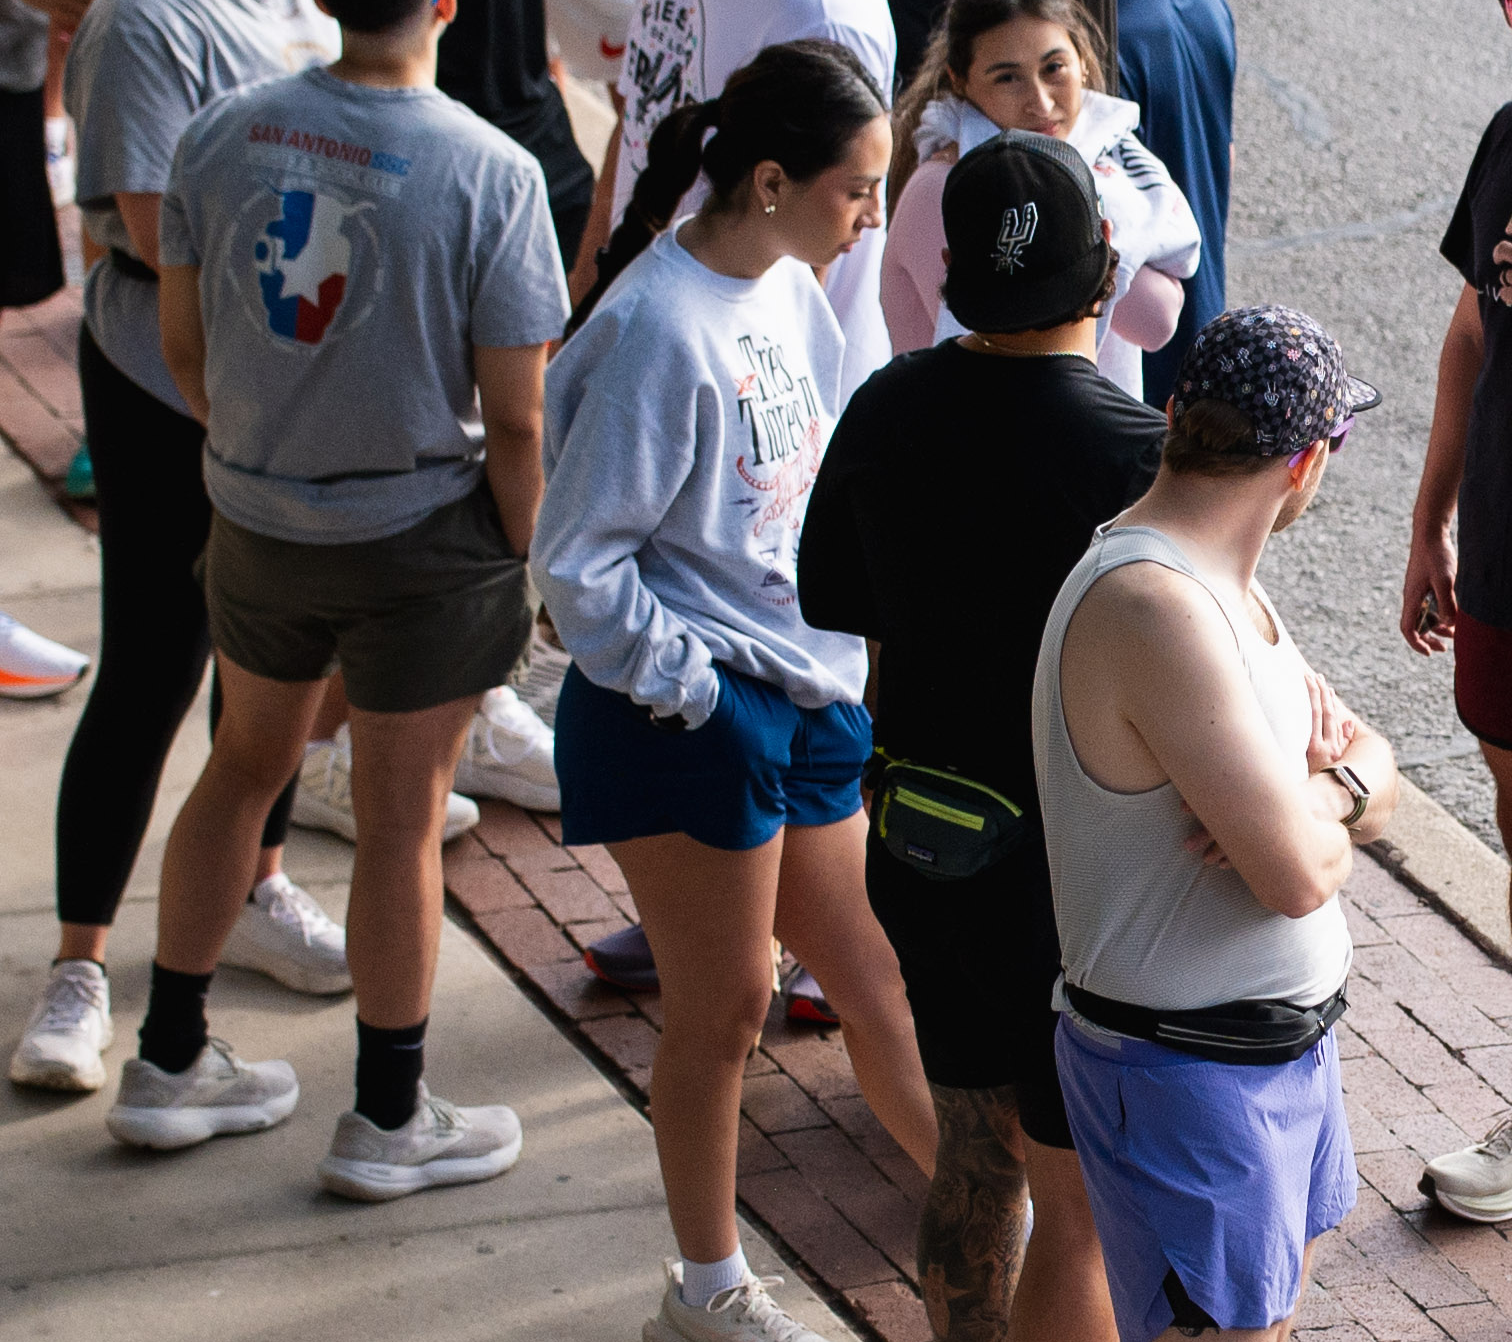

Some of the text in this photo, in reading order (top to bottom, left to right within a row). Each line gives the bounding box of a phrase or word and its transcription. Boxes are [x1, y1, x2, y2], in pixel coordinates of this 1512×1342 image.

[248, 122, 285, 145] SAN
[286, 128, 372, 168] ANTONIO
[737, 334, 794, 403] Très
[737, 395, 805, 467] Tigres
